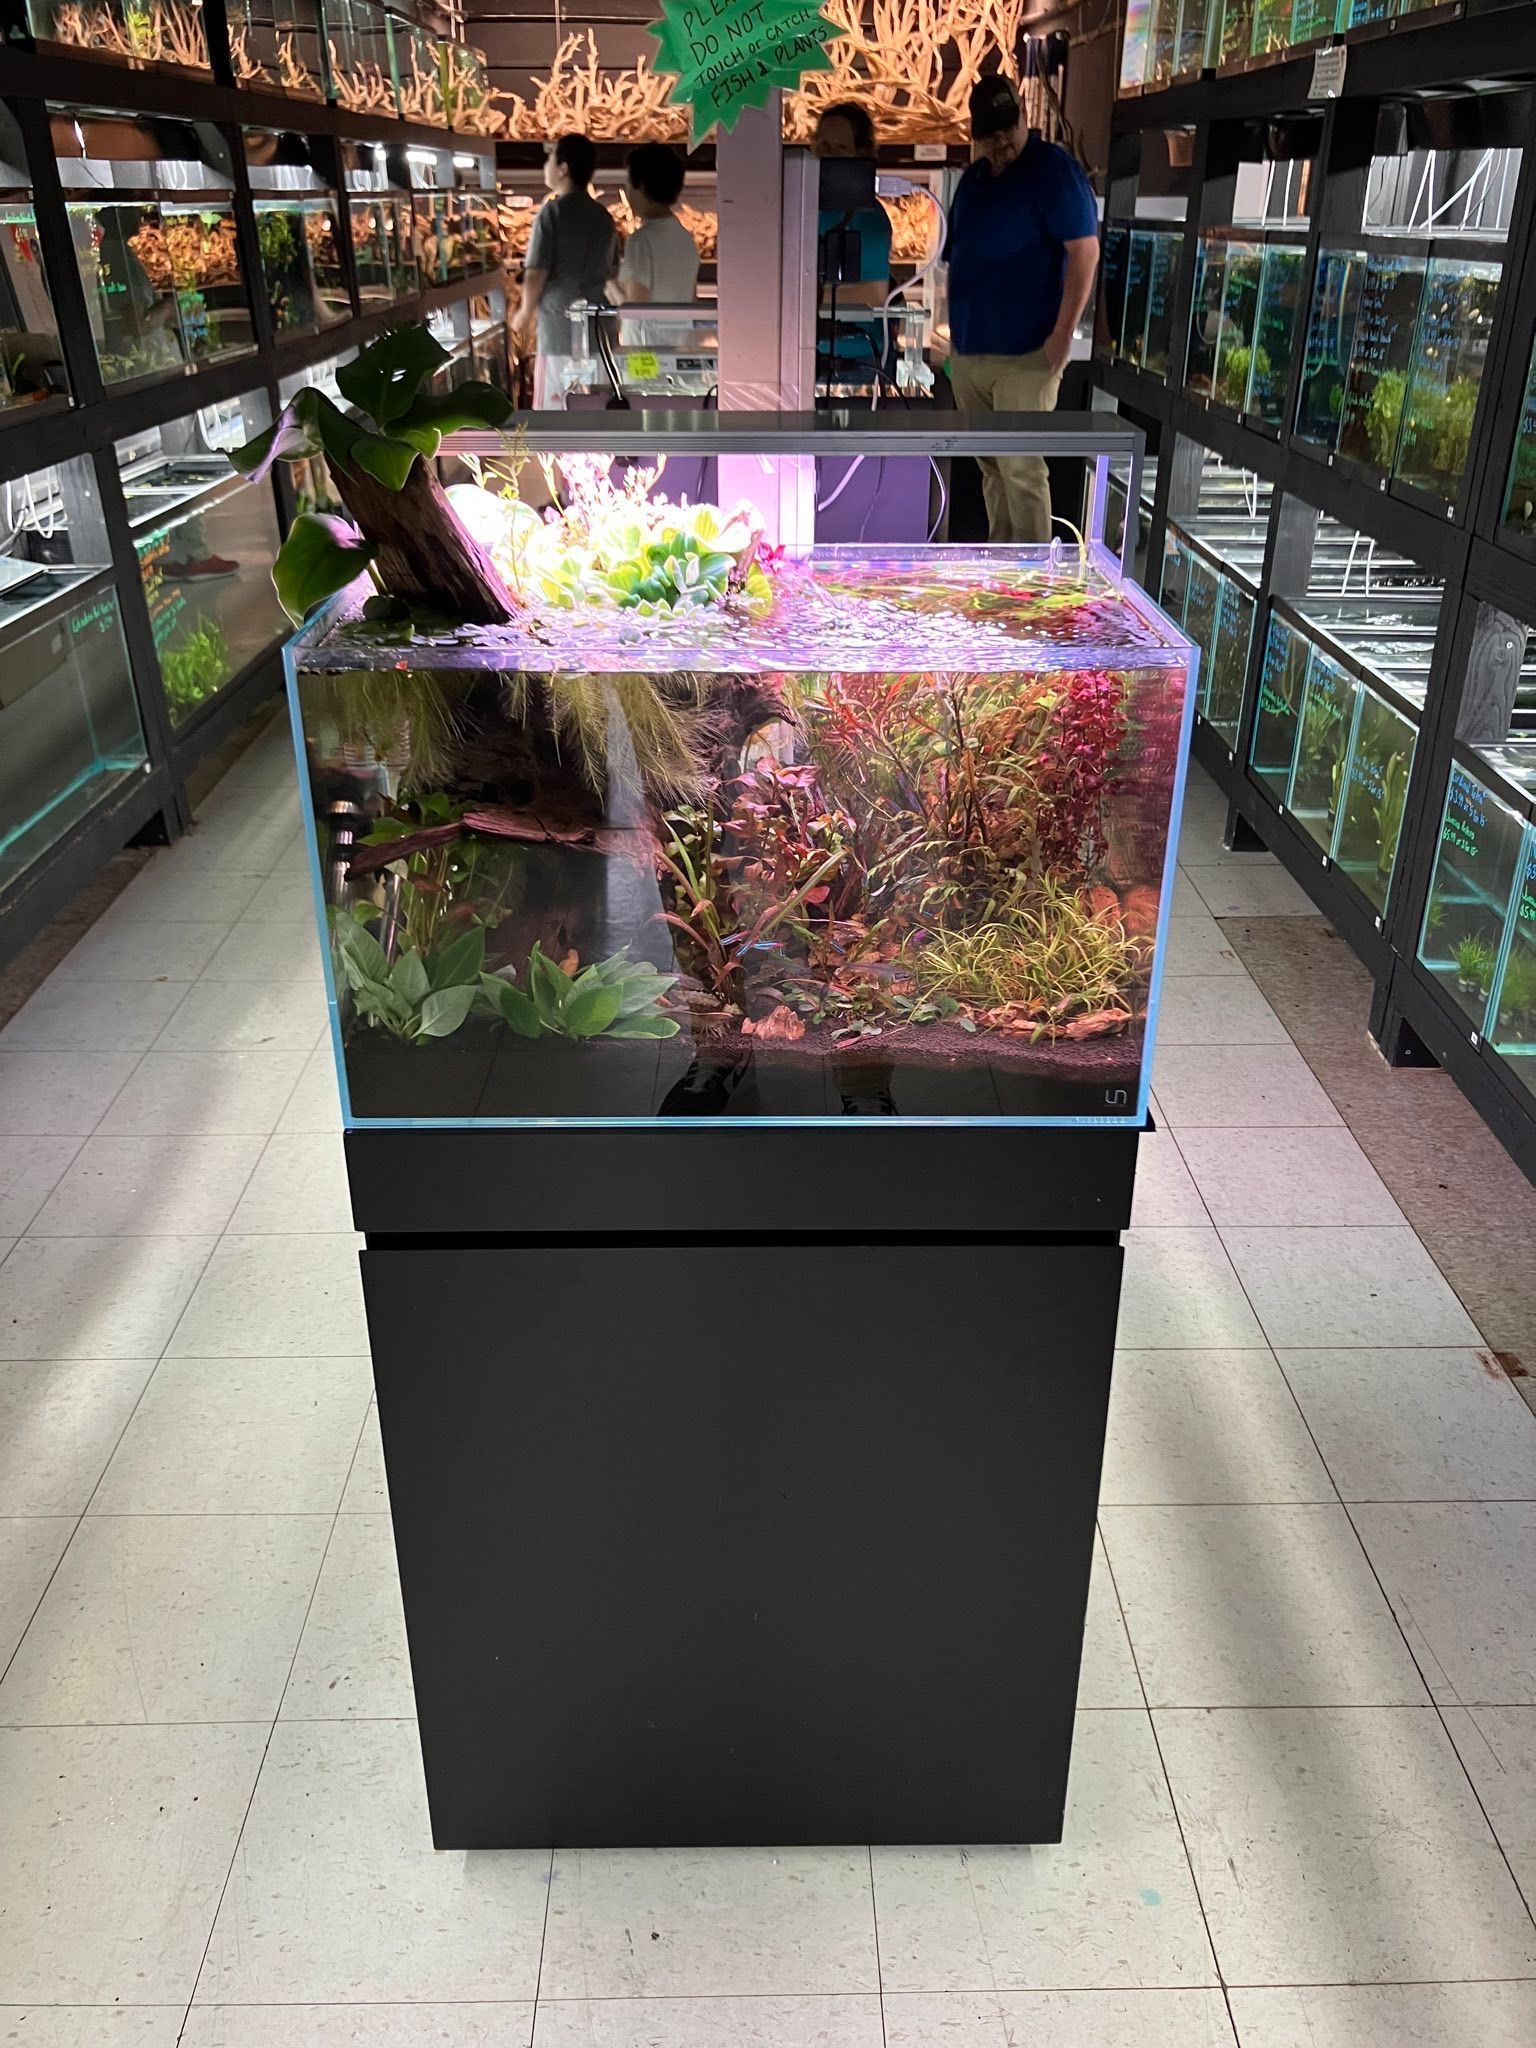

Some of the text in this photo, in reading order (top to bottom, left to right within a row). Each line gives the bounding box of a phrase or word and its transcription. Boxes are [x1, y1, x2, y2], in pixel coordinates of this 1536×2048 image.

[689, 1, 766, 67] DO NOT
[693, 47, 745, 87] TOUCH
[765, 8, 811, 41] CATCH
[710, 70, 756, 108] FISH
[774, 25, 828, 65] PLANTS
